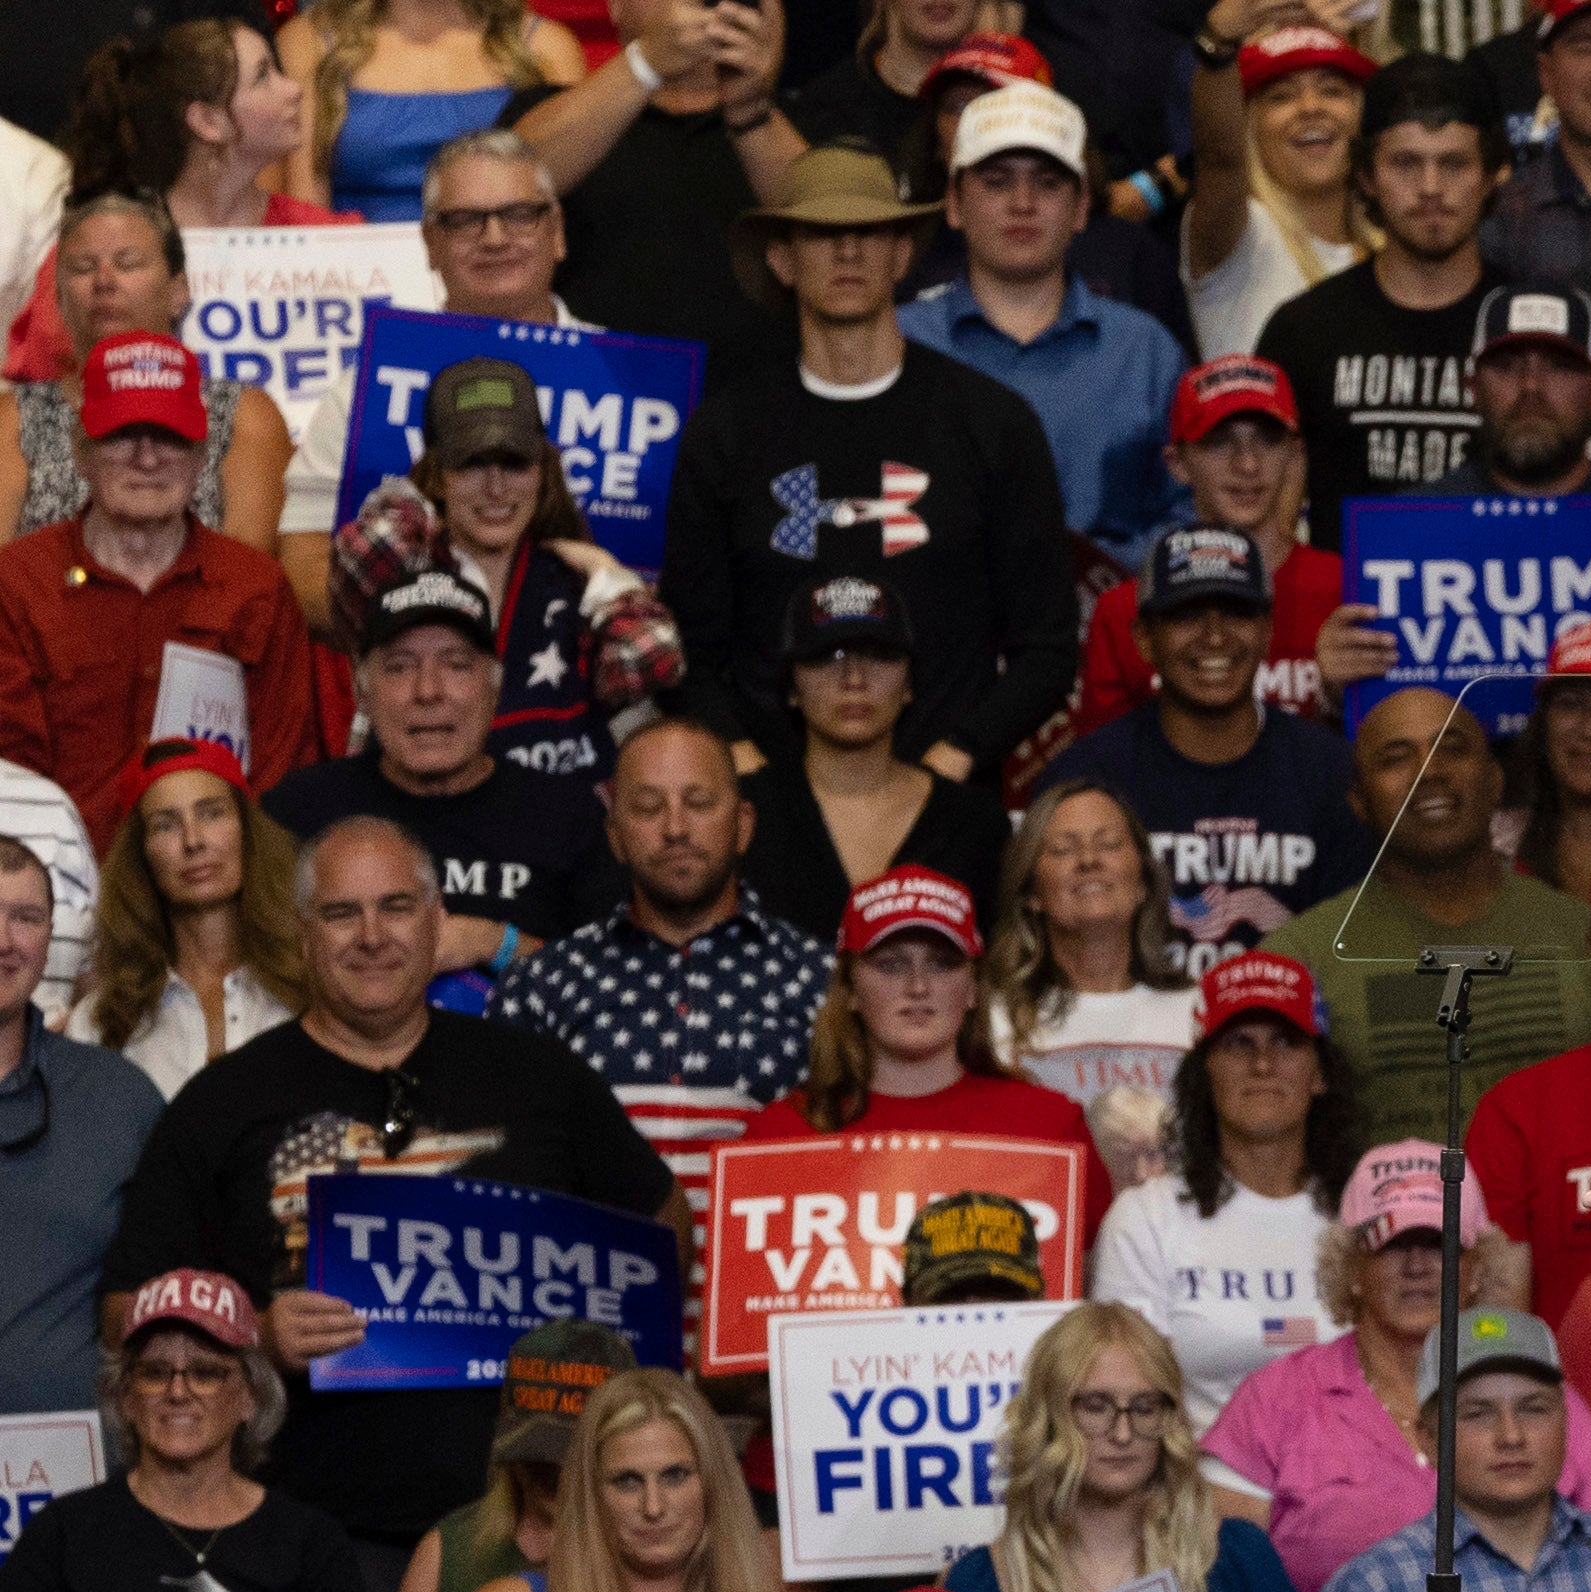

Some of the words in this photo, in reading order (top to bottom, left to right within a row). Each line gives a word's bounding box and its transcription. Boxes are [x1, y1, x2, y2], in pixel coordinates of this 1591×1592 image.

[199, 297, 394, 342] OU'R
[1335, 355, 1475, 407] MONTA
[377, 366, 681, 455] TMP
[1148, 833, 1317, 885] TRUMP
[333, 1213, 659, 1293] TRUMP
[763, 1249, 908, 1293] VAN
[133, 1278, 237, 1325] MAGA
[370, 1262, 625, 1326] VANCE
[1175, 1266, 1298, 1301] TRU
[414, 1311, 500, 1327] AMERICA
[548, 1361, 614, 1388] AMERIC
[830, 1350, 913, 1386] LYIN'
[931, 1349, 1021, 1386] KAM
[830, 1382, 1022, 1440] YOU'
